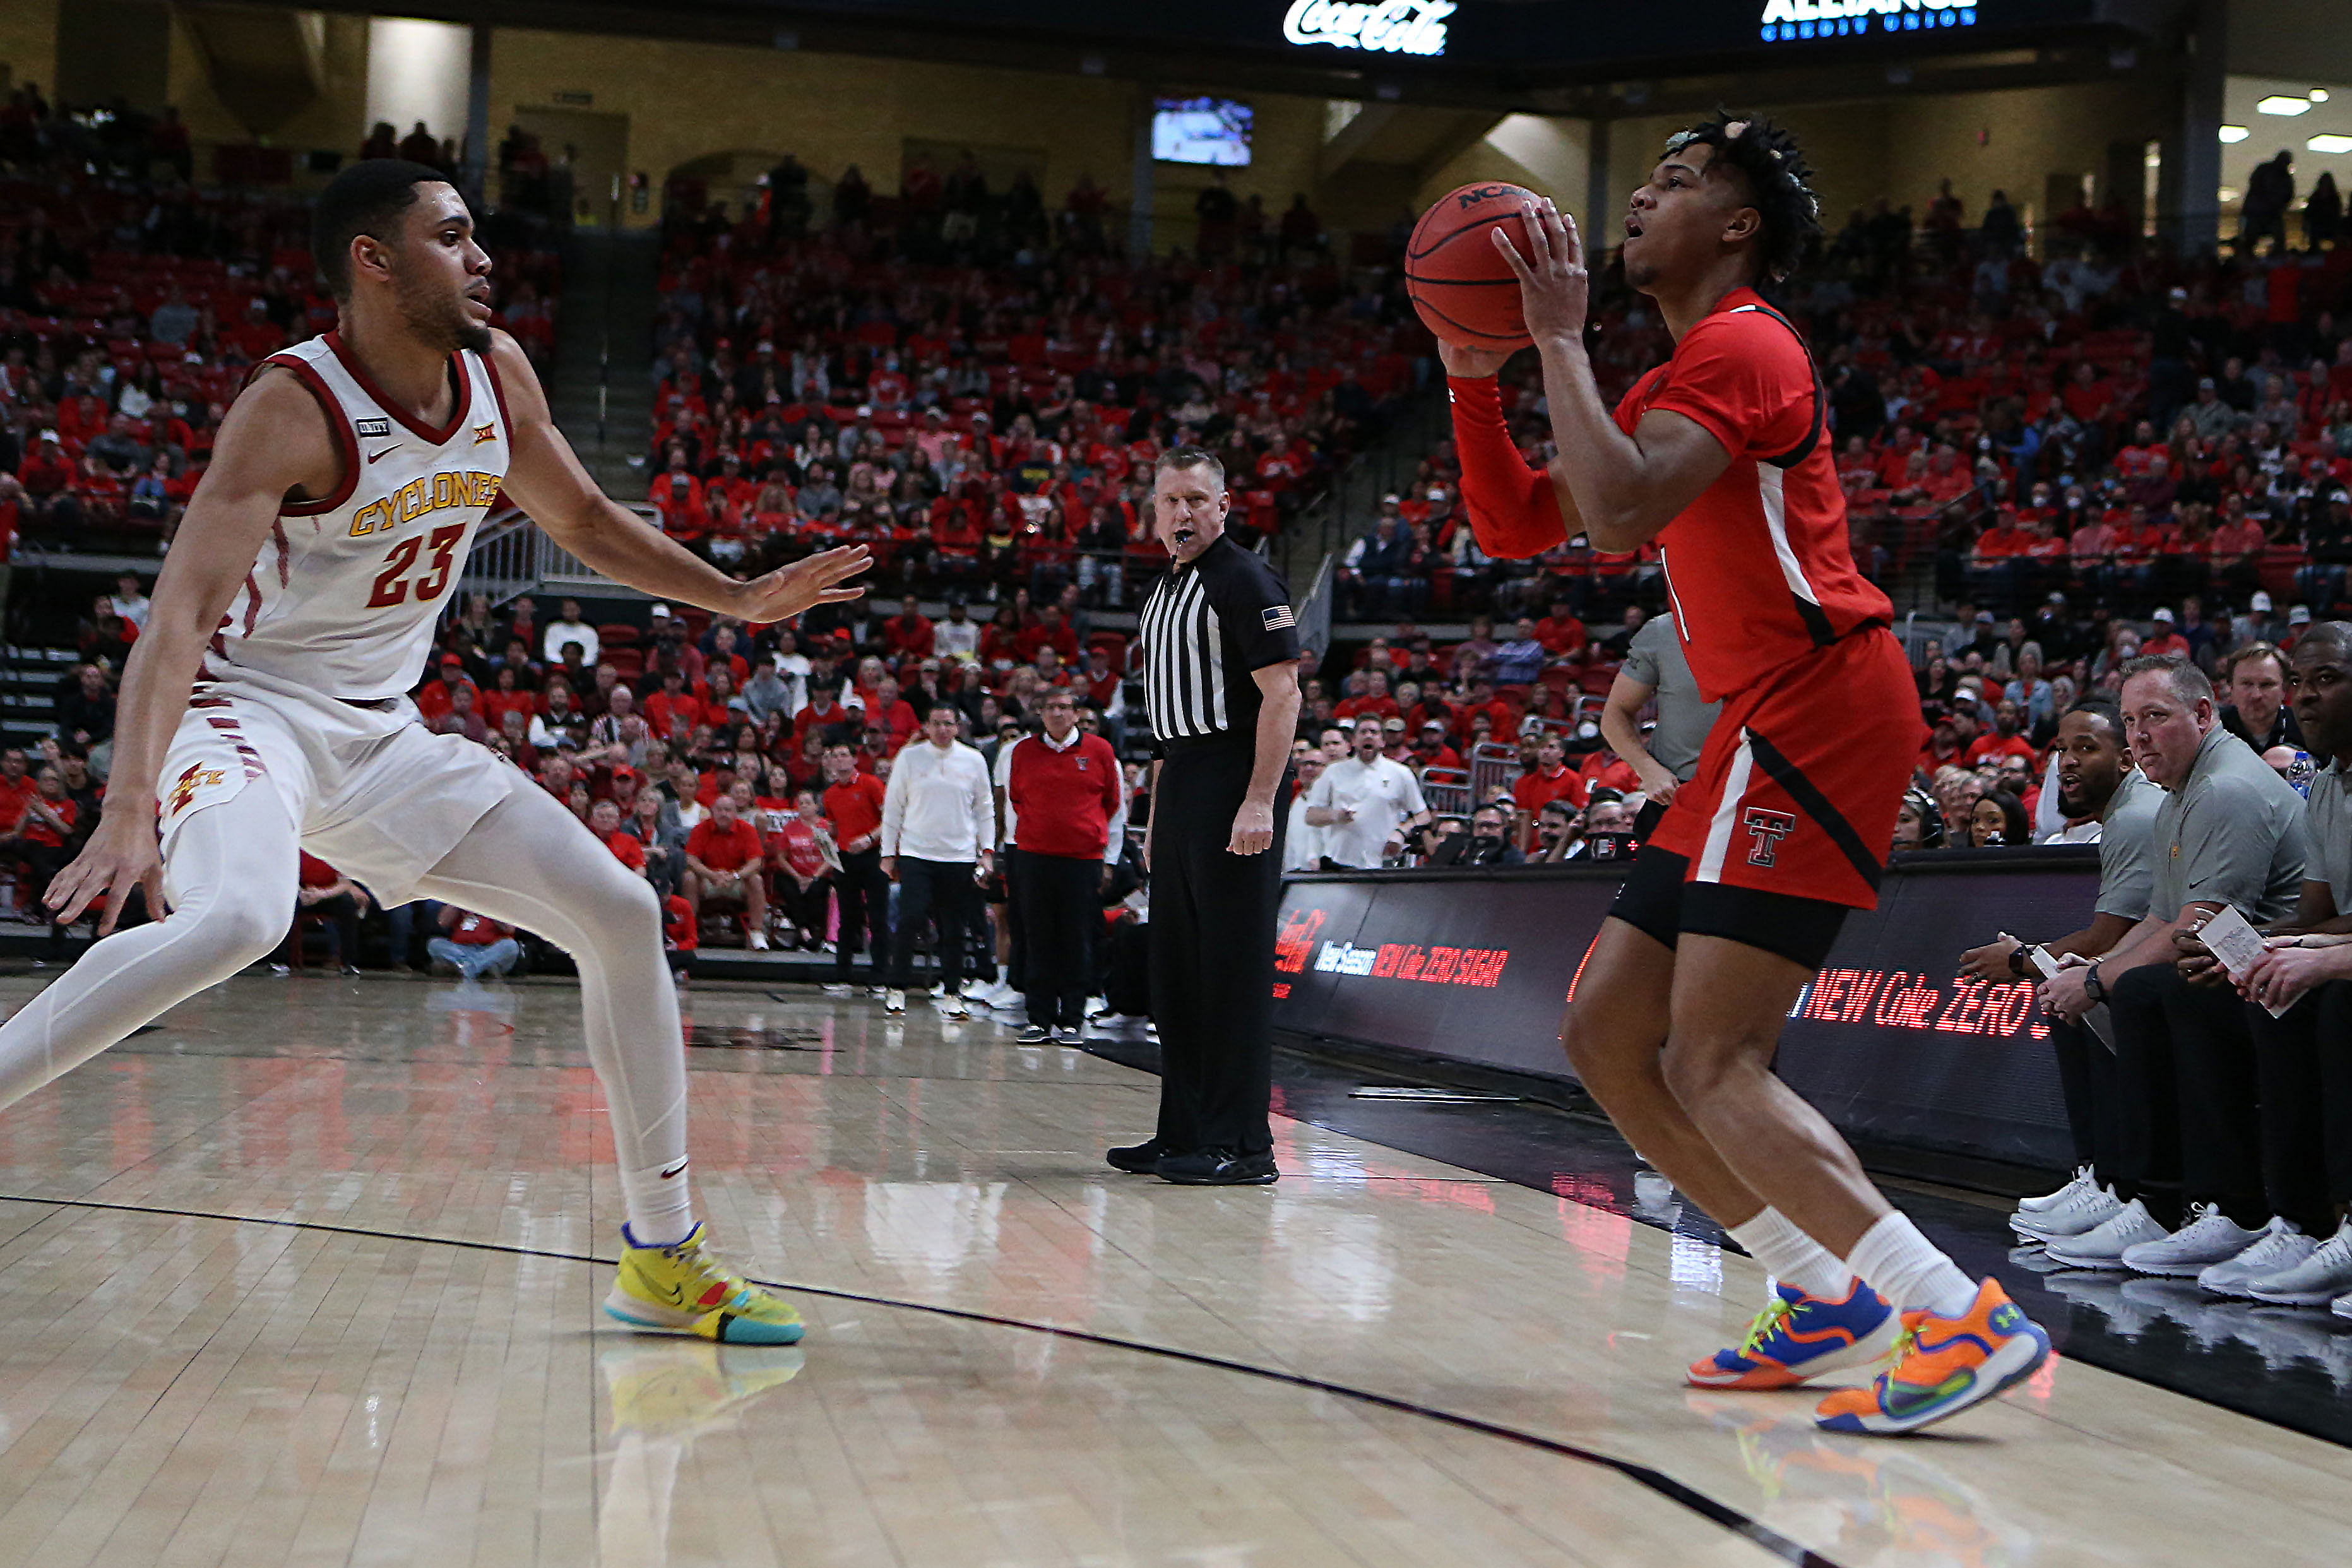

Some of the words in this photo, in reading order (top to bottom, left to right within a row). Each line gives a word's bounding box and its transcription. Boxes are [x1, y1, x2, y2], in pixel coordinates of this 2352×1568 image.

[364, 521, 467, 609] 23
[1803, 968, 1884, 1023] NEW
[1874, 971, 1939, 1030] Coke
[1934, 977, 2034, 1037] ZERO
